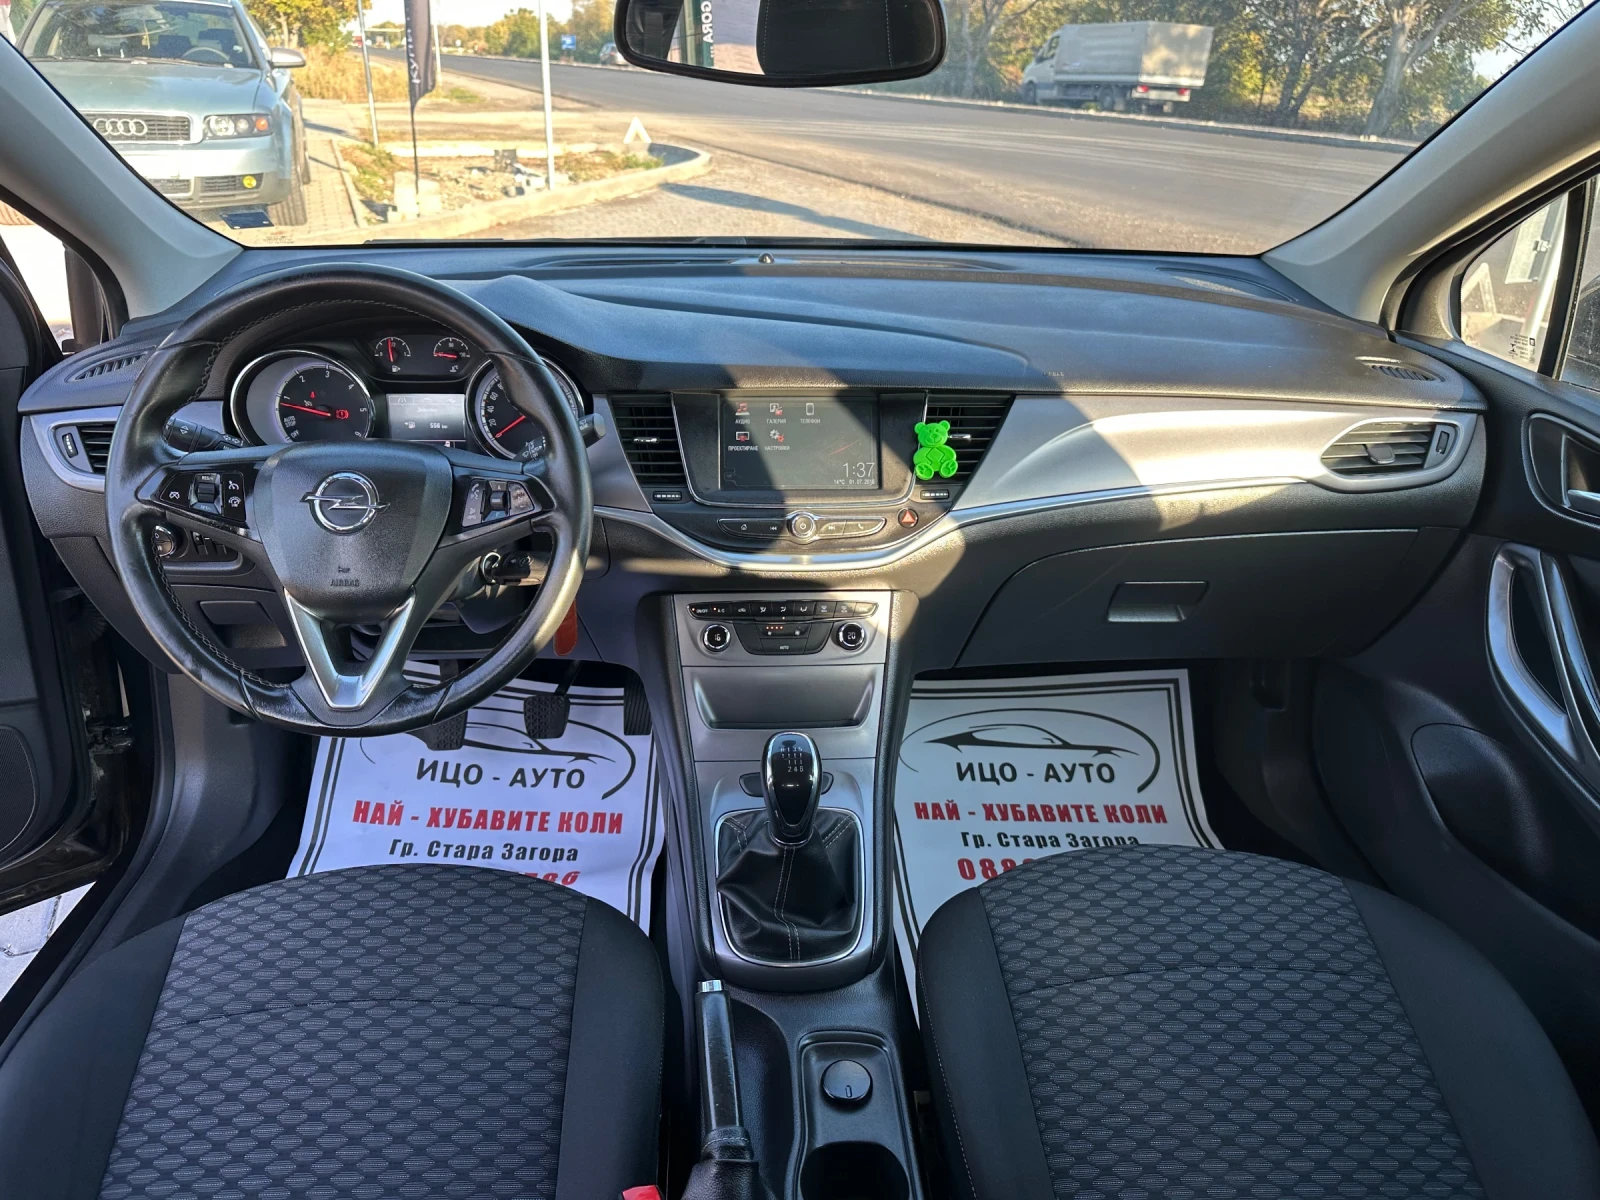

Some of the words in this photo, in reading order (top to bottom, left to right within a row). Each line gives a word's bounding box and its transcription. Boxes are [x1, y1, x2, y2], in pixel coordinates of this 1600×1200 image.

[842, 462, 876, 478] 1:37
[416, 757, 483, 788] ИЦО
[508, 767, 585, 789] АУТО
[955, 762, 1018, 786] ИЦО
[1044, 763, 1116, 783] АУТО
[352, 800, 405, 826] НАЙ
[425, 807, 551, 832] ХУБАВИТЕ
[557, 811, 624, 834] КОЛИ
[914, 799, 961, 821] НАЙ
[981, 803, 1100, 823] ХУБАВИТЕ
[1103, 804, 1168, 824] КОЛИ
[388, 838, 419, 858] Гр.
[426, 840, 495, 860] Стара
[501, 842, 579, 863] Загора
[960, 831, 992, 849] Гр.
[998, 831, 1061, 849] Стара
